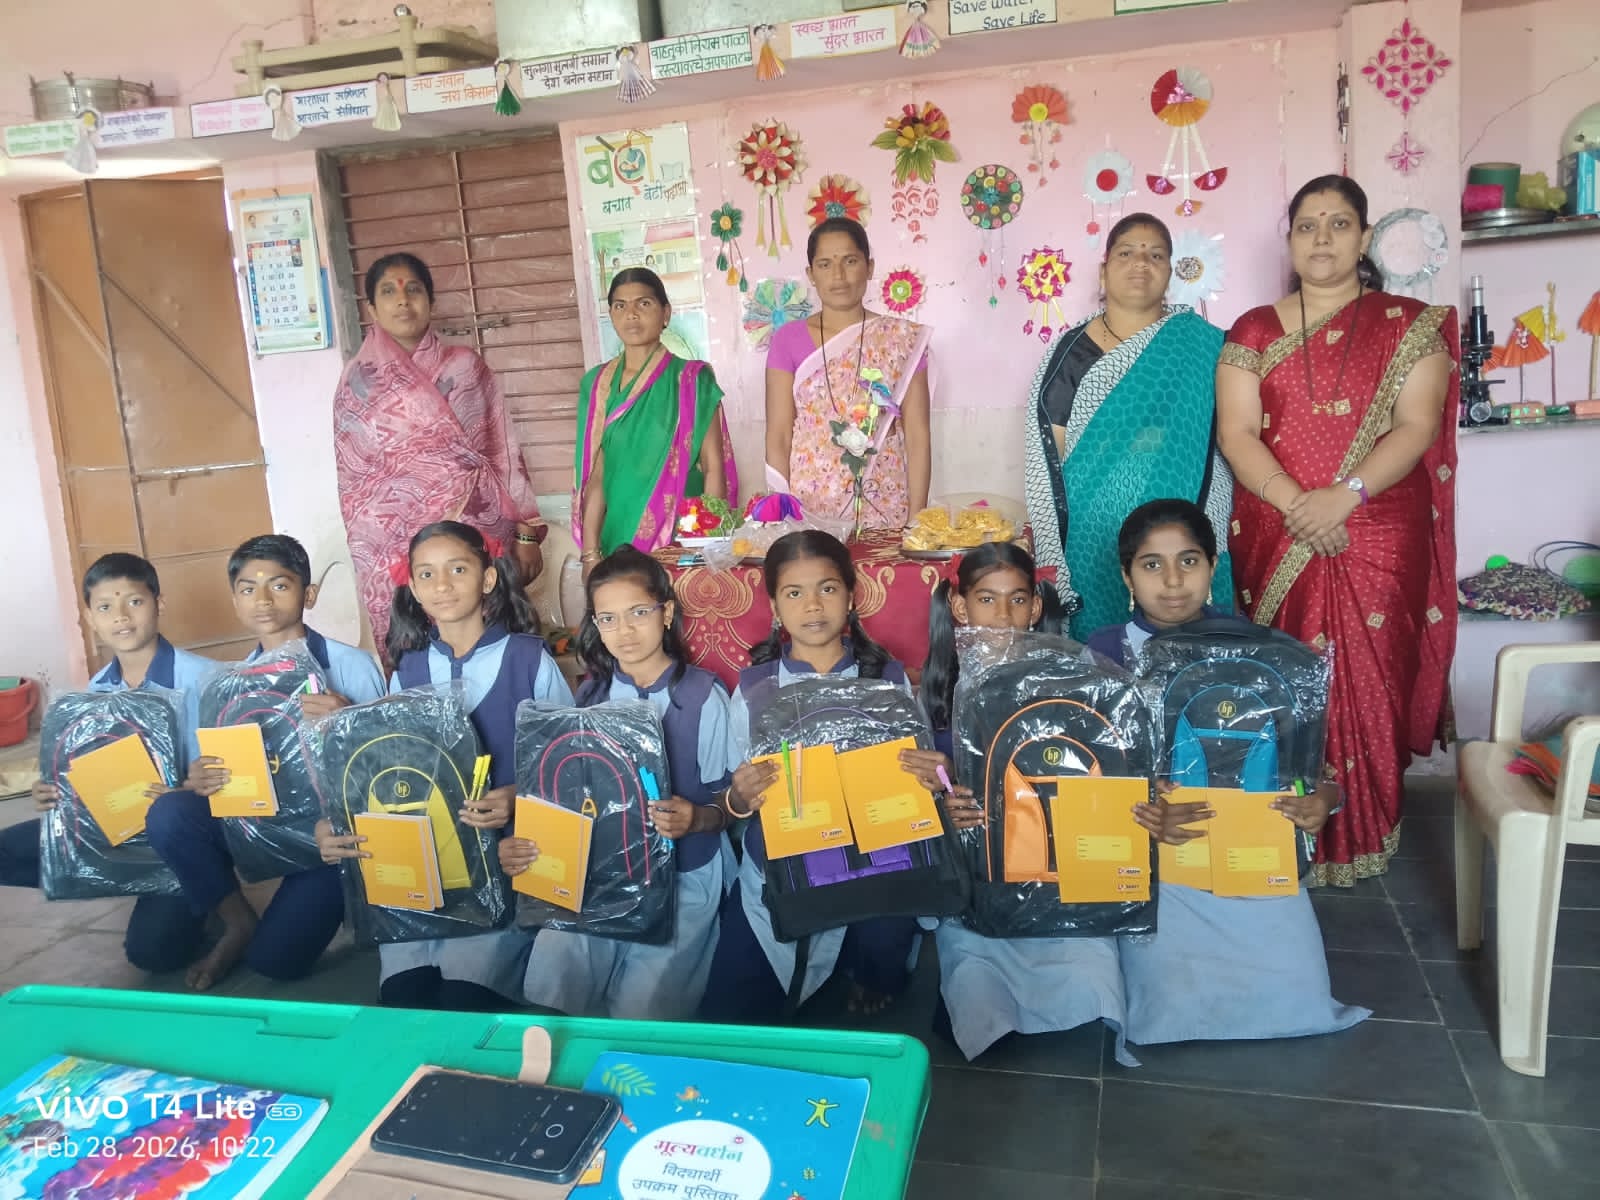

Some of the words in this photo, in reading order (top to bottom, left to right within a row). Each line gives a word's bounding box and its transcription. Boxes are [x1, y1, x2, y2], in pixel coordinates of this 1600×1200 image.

[953, 1, 987, 14] Save
[827, 15, 860, 31] भारत
[983, 15, 1015, 30] Save
[1020, 9, 1046, 25] Life
[853, 27, 886, 44] भारत
